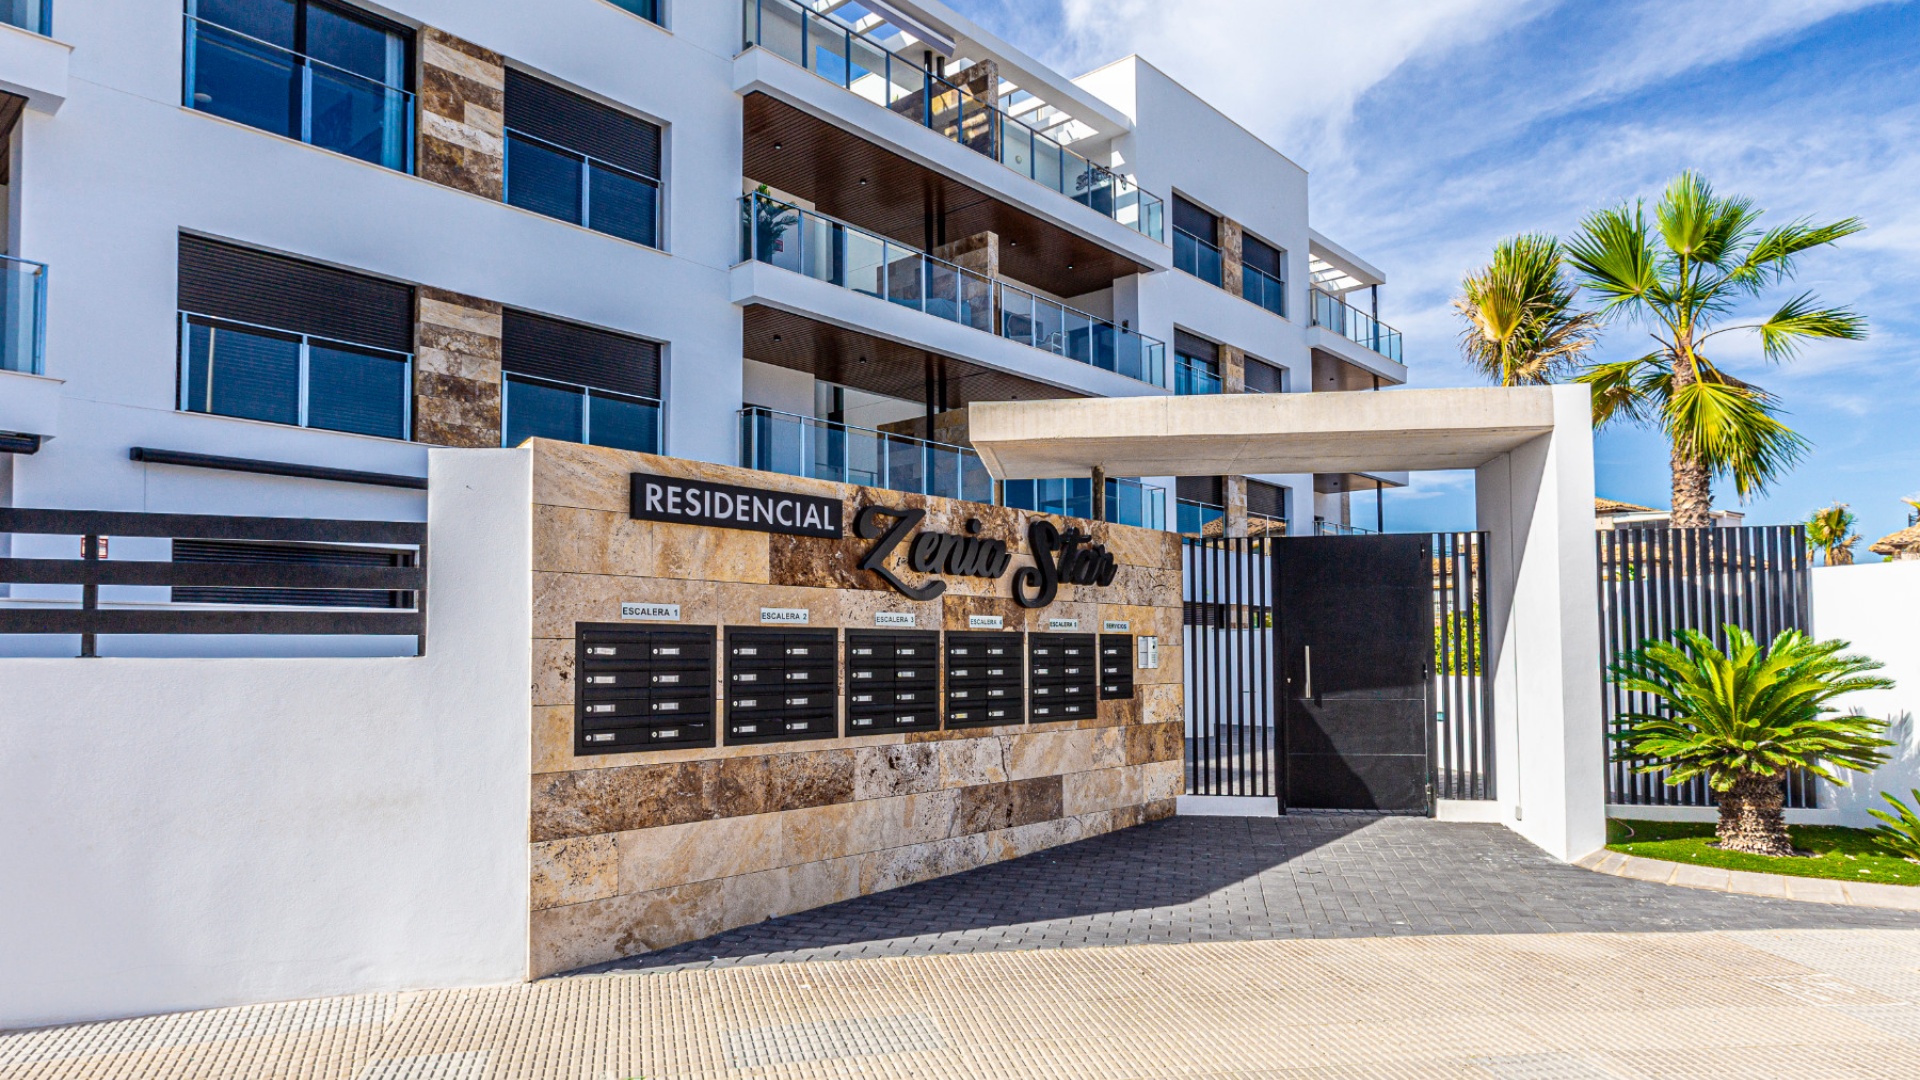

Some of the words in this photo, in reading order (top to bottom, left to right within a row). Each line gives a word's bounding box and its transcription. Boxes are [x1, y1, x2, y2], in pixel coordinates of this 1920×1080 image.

[645, 483, 835, 531] RESIDENCIAL
[853, 505, 1011, 600] Zenia
[1012, 520, 1119, 608] Star
[622, 606, 670, 616] ESCALERA
[673, 609, 678, 617] 1
[761, 612, 800, 620] ESCALERA
[802, 613, 807, 621] 2
